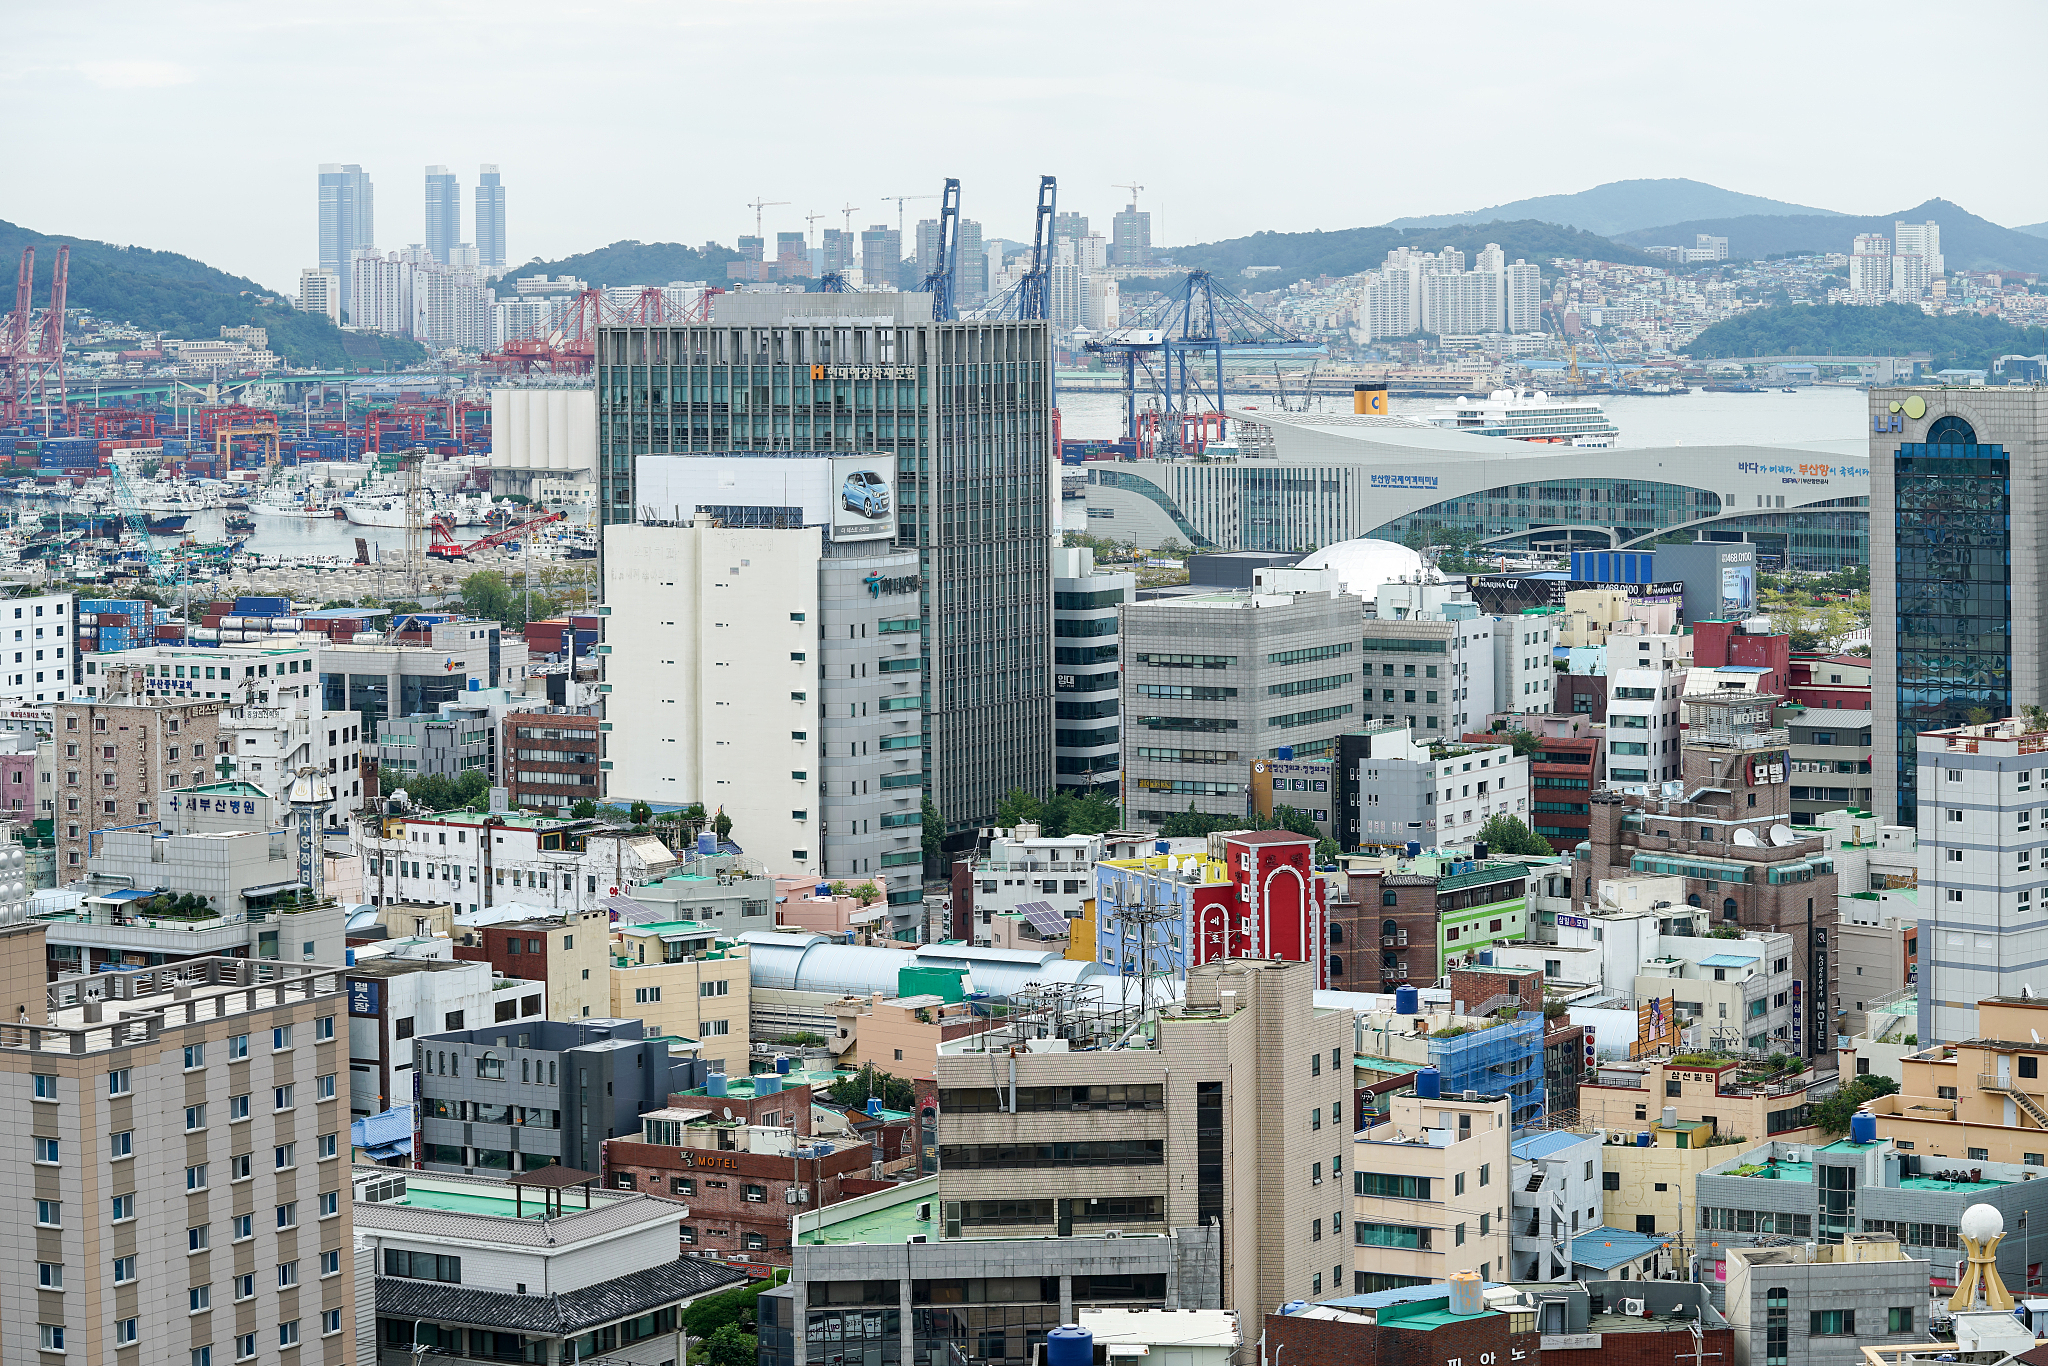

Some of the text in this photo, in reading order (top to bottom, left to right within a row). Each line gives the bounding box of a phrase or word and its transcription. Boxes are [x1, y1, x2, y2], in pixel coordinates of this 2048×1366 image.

[827, 367, 916, 380] 현대해상화재보험
[1874, 416, 1902, 432] LH
[1738, 462, 1767, 474] 바다가
[1370, 474, 1438, 485] 부산항국제여객터미널
[1506, 579, 1519, 589] G7
[1672, 583, 1683, 593] G7
[149, 679, 193, 690] 부산중부교회
[1058, 675, 1075, 684] 임대
[1733, 710, 1769, 725] MOTEL
[1754, 763, 1784, 786] 모텔
[354, 981, 370, 1013] 헬스장
[1817, 1001, 1826, 1050] MOTEL
[1671, 1071, 1714, 1083] 삼선빌딩
[698, 1156, 738, 1169] MOTEL
[1447, 1347, 1526, 1366] 피아노
